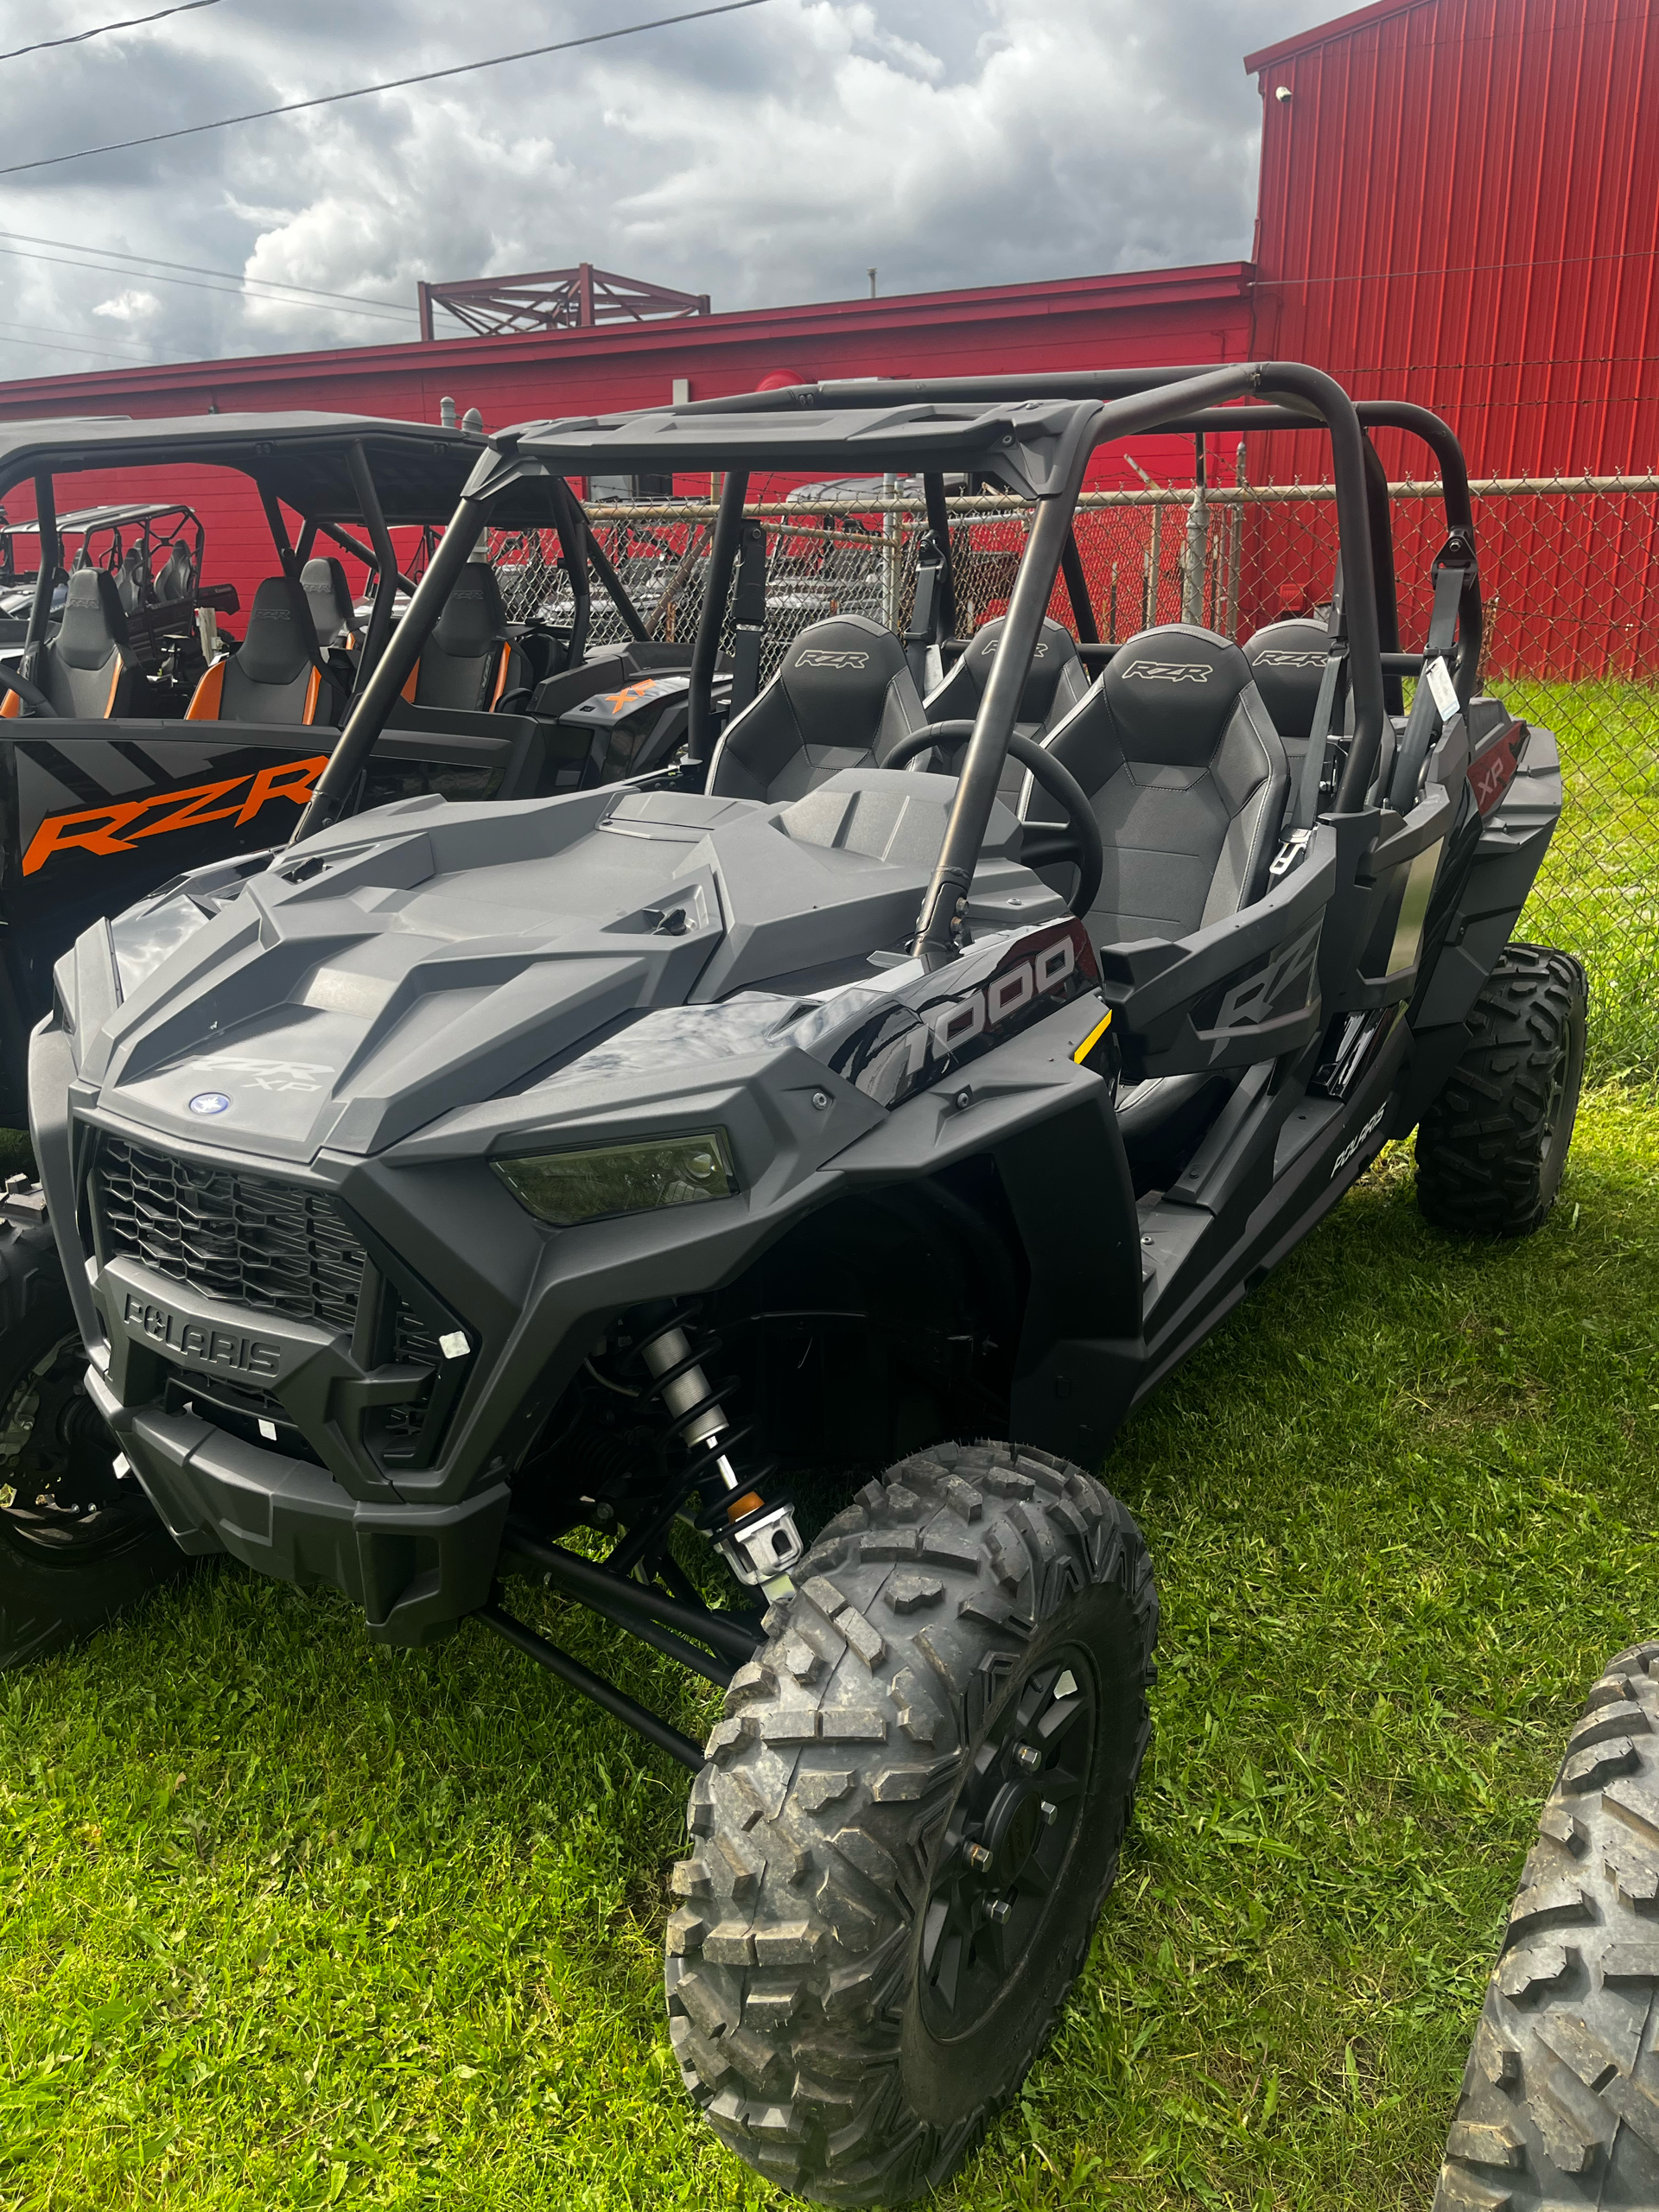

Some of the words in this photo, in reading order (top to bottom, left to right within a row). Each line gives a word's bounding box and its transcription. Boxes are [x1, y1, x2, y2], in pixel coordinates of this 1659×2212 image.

[252, 608, 291, 620] RZR
[795, 650, 869, 669] RZR
[1122, 660, 1214, 682] RZR
[1252, 651, 1329, 667] RZR
[605, 678, 658, 715] XP
[1478, 757, 1503, 806] XP
[22, 755, 329, 877] RZR
[904, 934, 1076, 1076] 1000
[156, 1054, 336, 1082] RZR
[239, 1077, 324, 1092] XP
[1331, 1101, 1387, 1179] POLARIS
[124, 1293, 282, 1378] POLARIS
